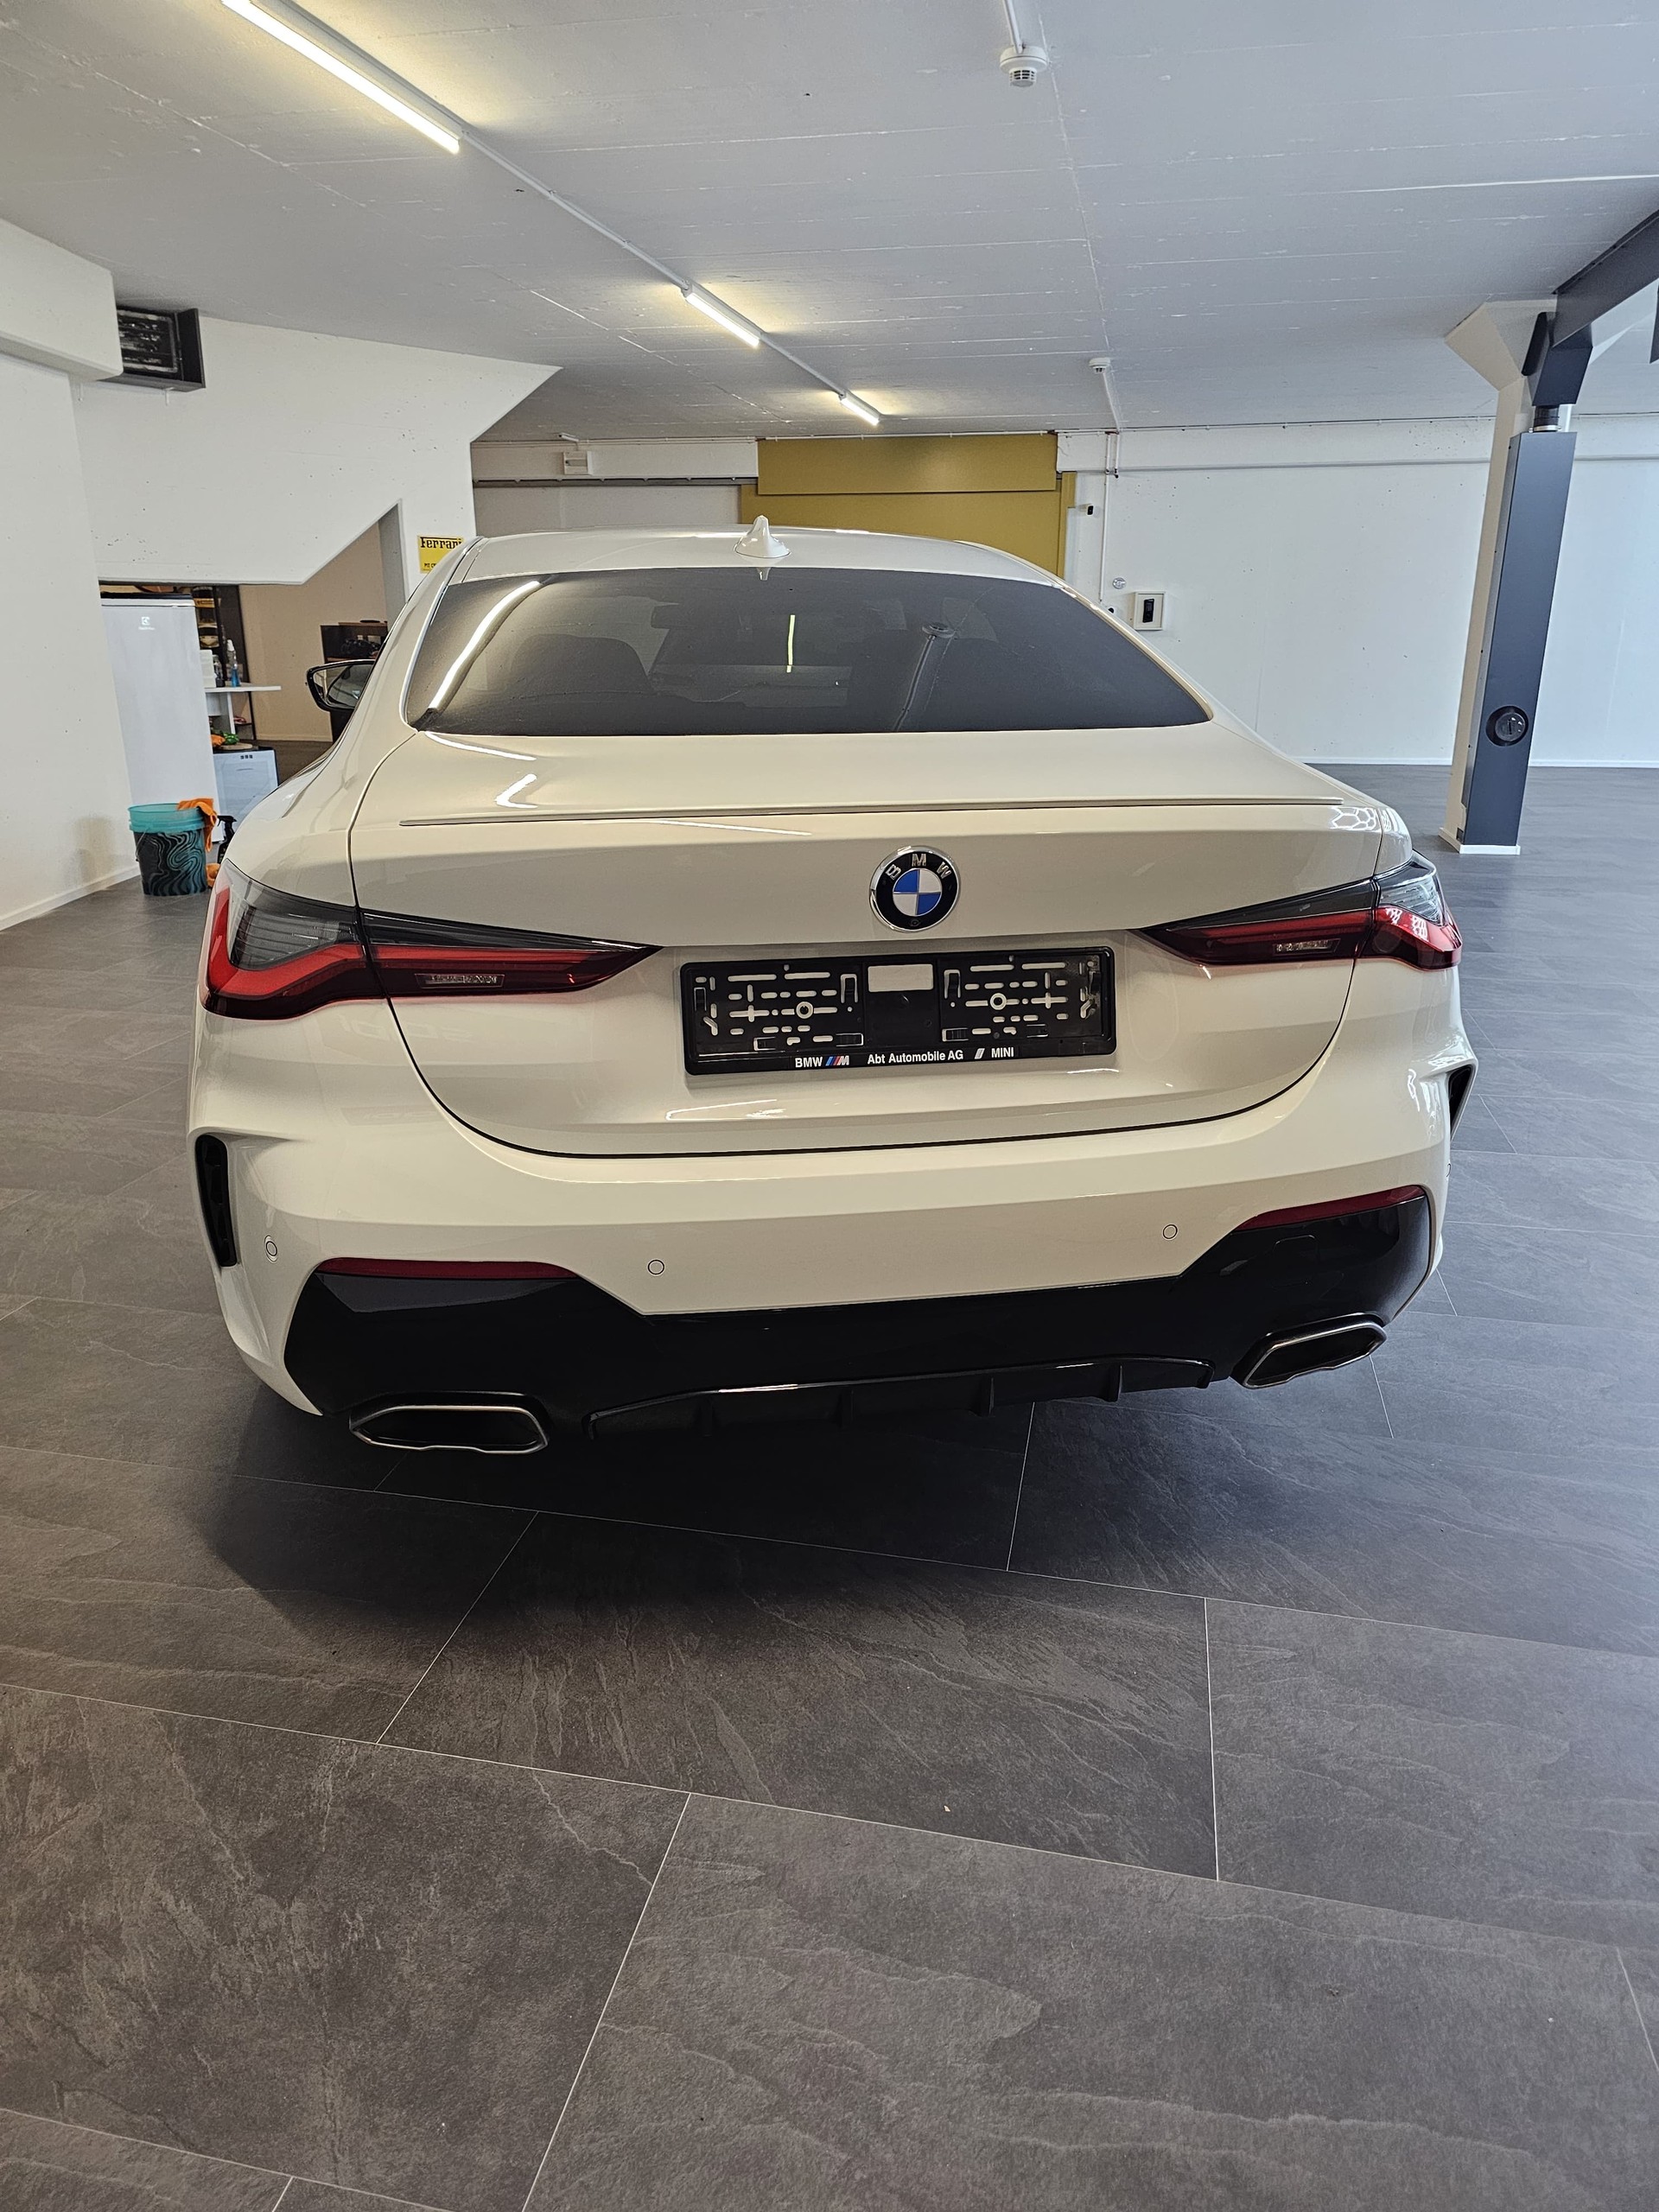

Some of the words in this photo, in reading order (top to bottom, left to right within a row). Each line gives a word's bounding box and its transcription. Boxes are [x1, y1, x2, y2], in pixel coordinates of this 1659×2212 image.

[886, 854, 951, 880] BMW
[795, 1056, 823, 1067] BMW
[868, 1054, 886, 1065] Abt
[888, 1051, 946, 1063] Automobile
[948, 1050, 963, 1060] AG
[991, 1047, 1014, 1058] MINI
